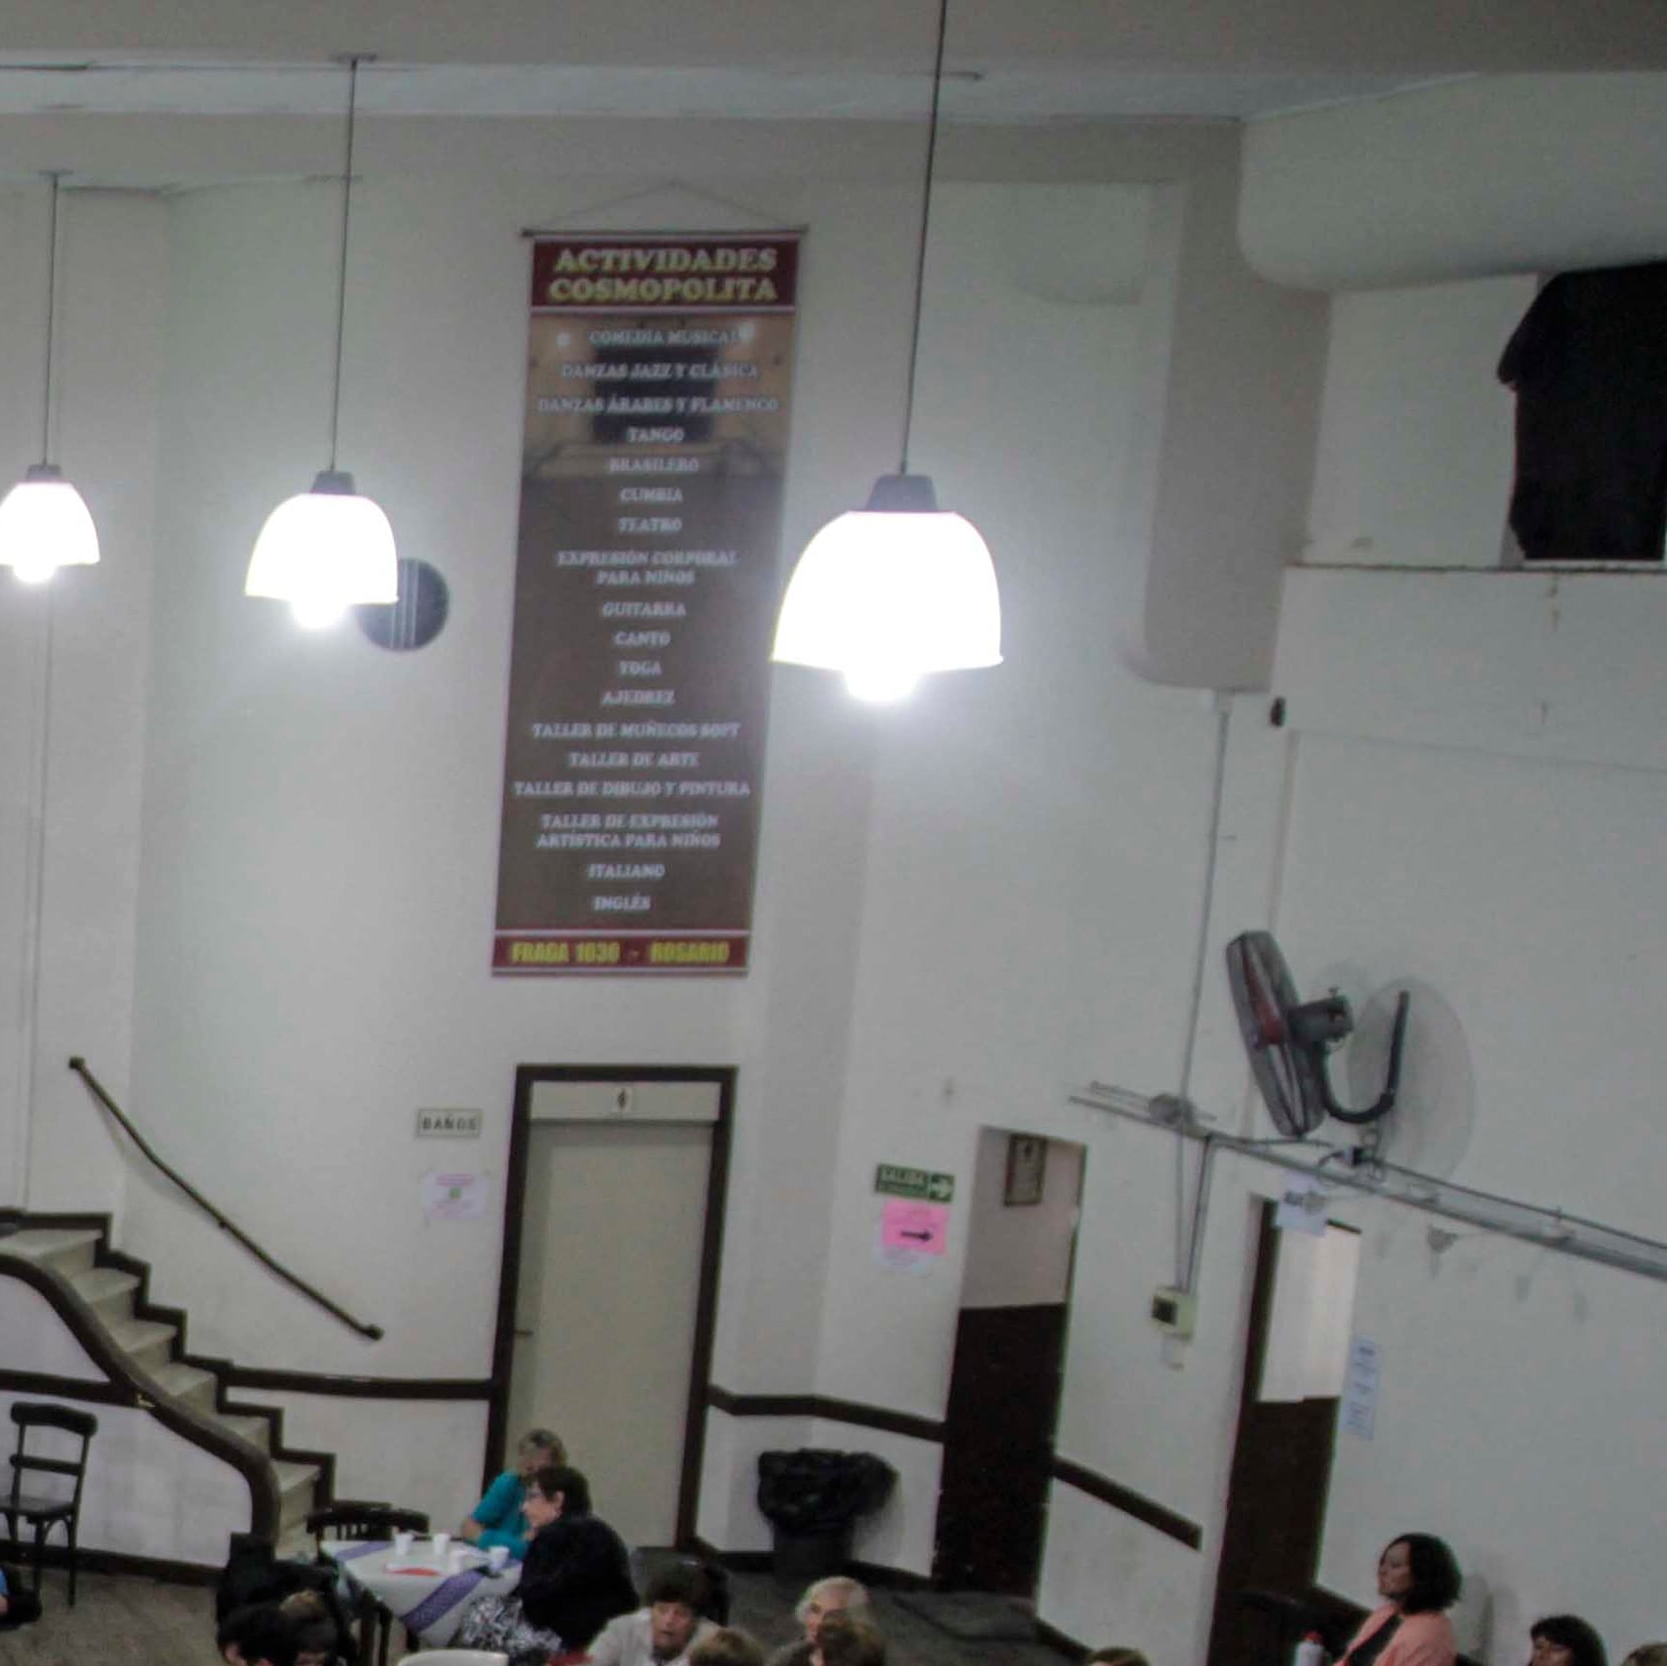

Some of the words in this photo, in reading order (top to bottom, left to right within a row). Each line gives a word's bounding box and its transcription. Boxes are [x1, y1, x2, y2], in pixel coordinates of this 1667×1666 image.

[554, 248, 777, 273] ACTIVIDADES
[548, 277, 777, 301] COSMOPOLITA
[561, 364, 627, 380] DANZAS
[629, 363, 671, 380] JAZZ
[626, 427, 685, 443] TANGO
[614, 631, 671, 646] CANTO
[619, 660, 662, 675] YOGA
[602, 689, 676, 705] AJEDREZ
[533, 723, 592, 738] TALLER
[596, 723, 616, 737] DE
[570, 752, 629, 767] TALLER
[658, 752, 700, 767] ARTE
[515, 781, 574, 796] TALLER
[577, 781, 599, 796] DE
[602, 781, 662, 796] DIBUJO
[665, 782, 678, 795] Y
[680, 781, 751, 796] PINTURA
[541, 814, 601, 829] TALLER
[626, 834, 667, 847] PARA
[587, 864, 665, 879] ITALIANO
[511, 941, 570, 964] FRAGA
[650, 941, 730, 963] ROSARIO
